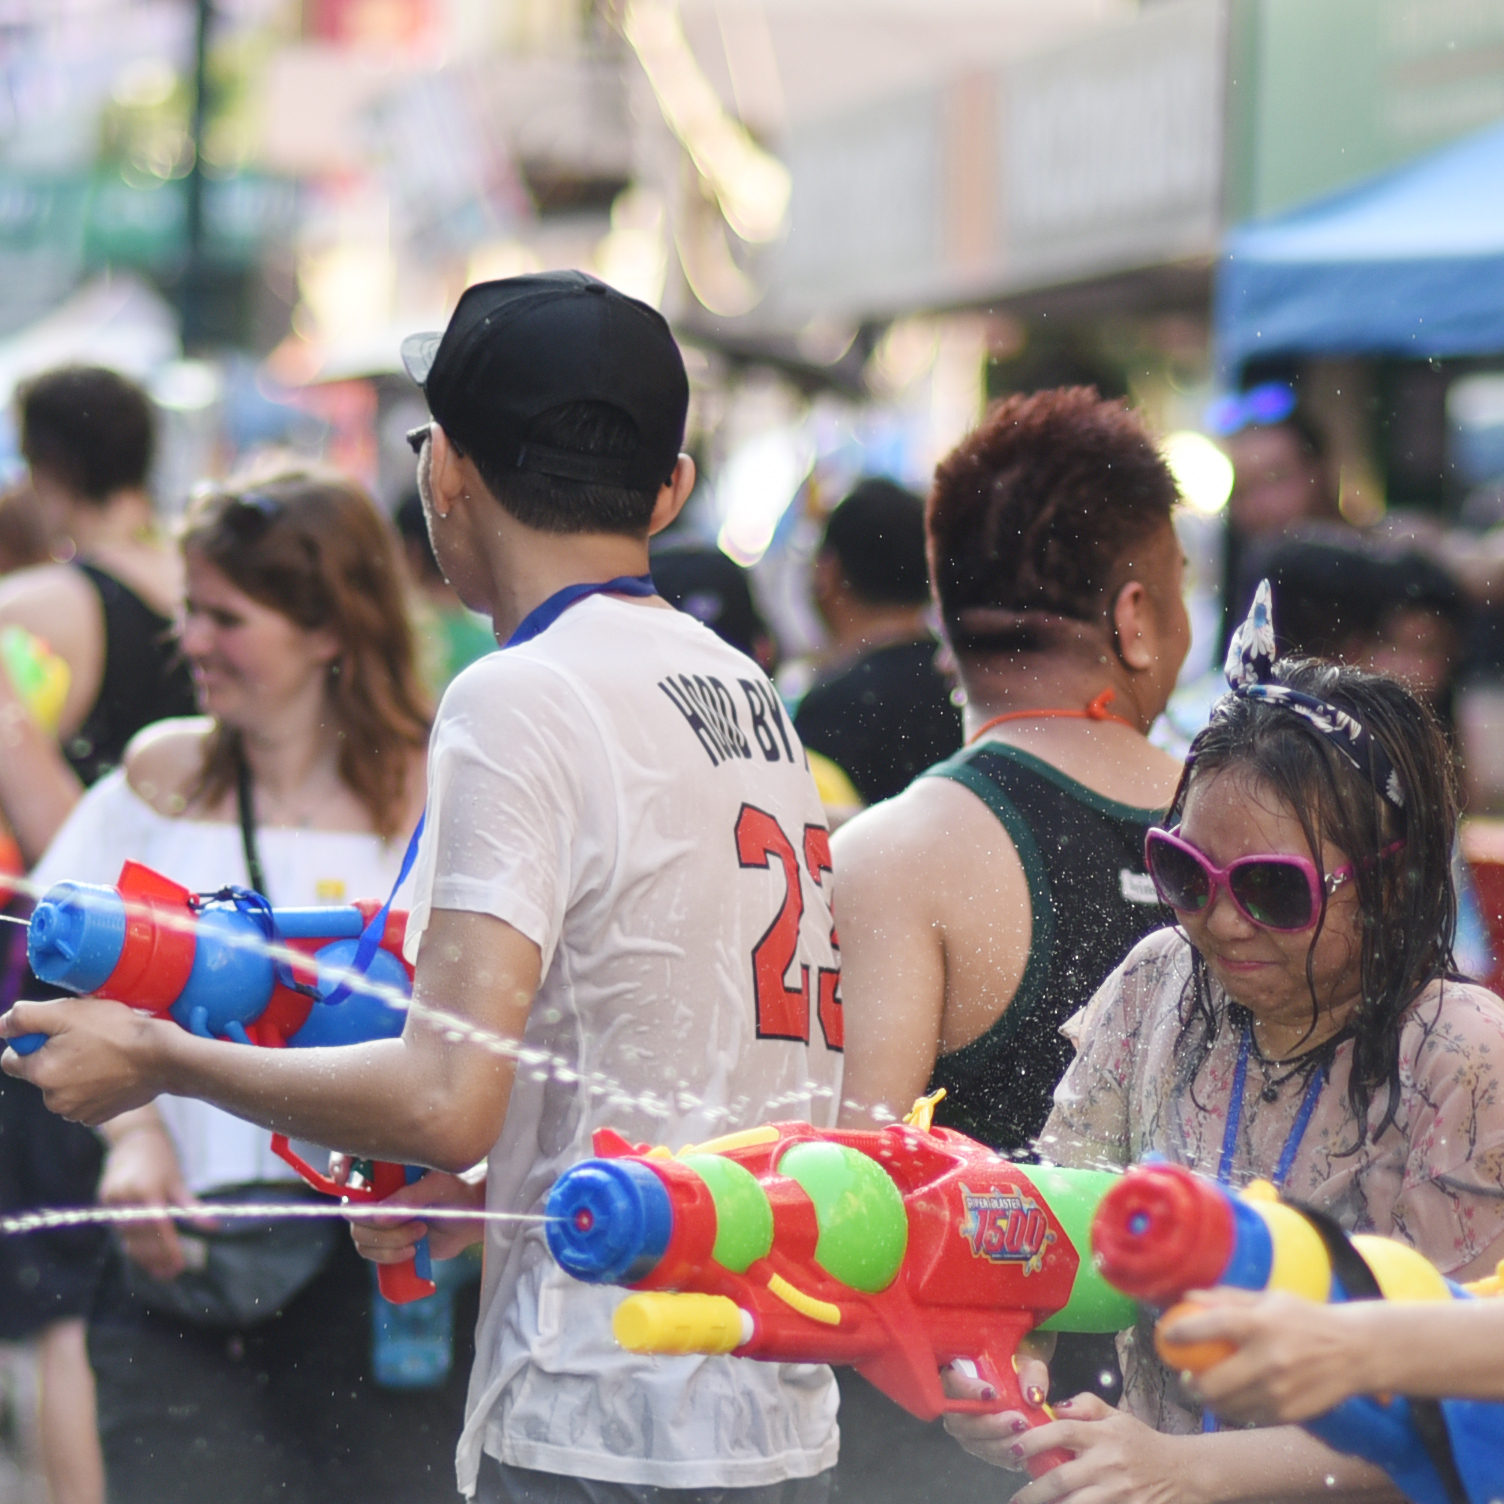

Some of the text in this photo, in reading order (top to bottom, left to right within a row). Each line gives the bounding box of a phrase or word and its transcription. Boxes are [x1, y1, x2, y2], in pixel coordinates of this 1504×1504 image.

[657, 672, 795, 768] HOOD BY
[973, 1207, 1047, 1255] 1500
